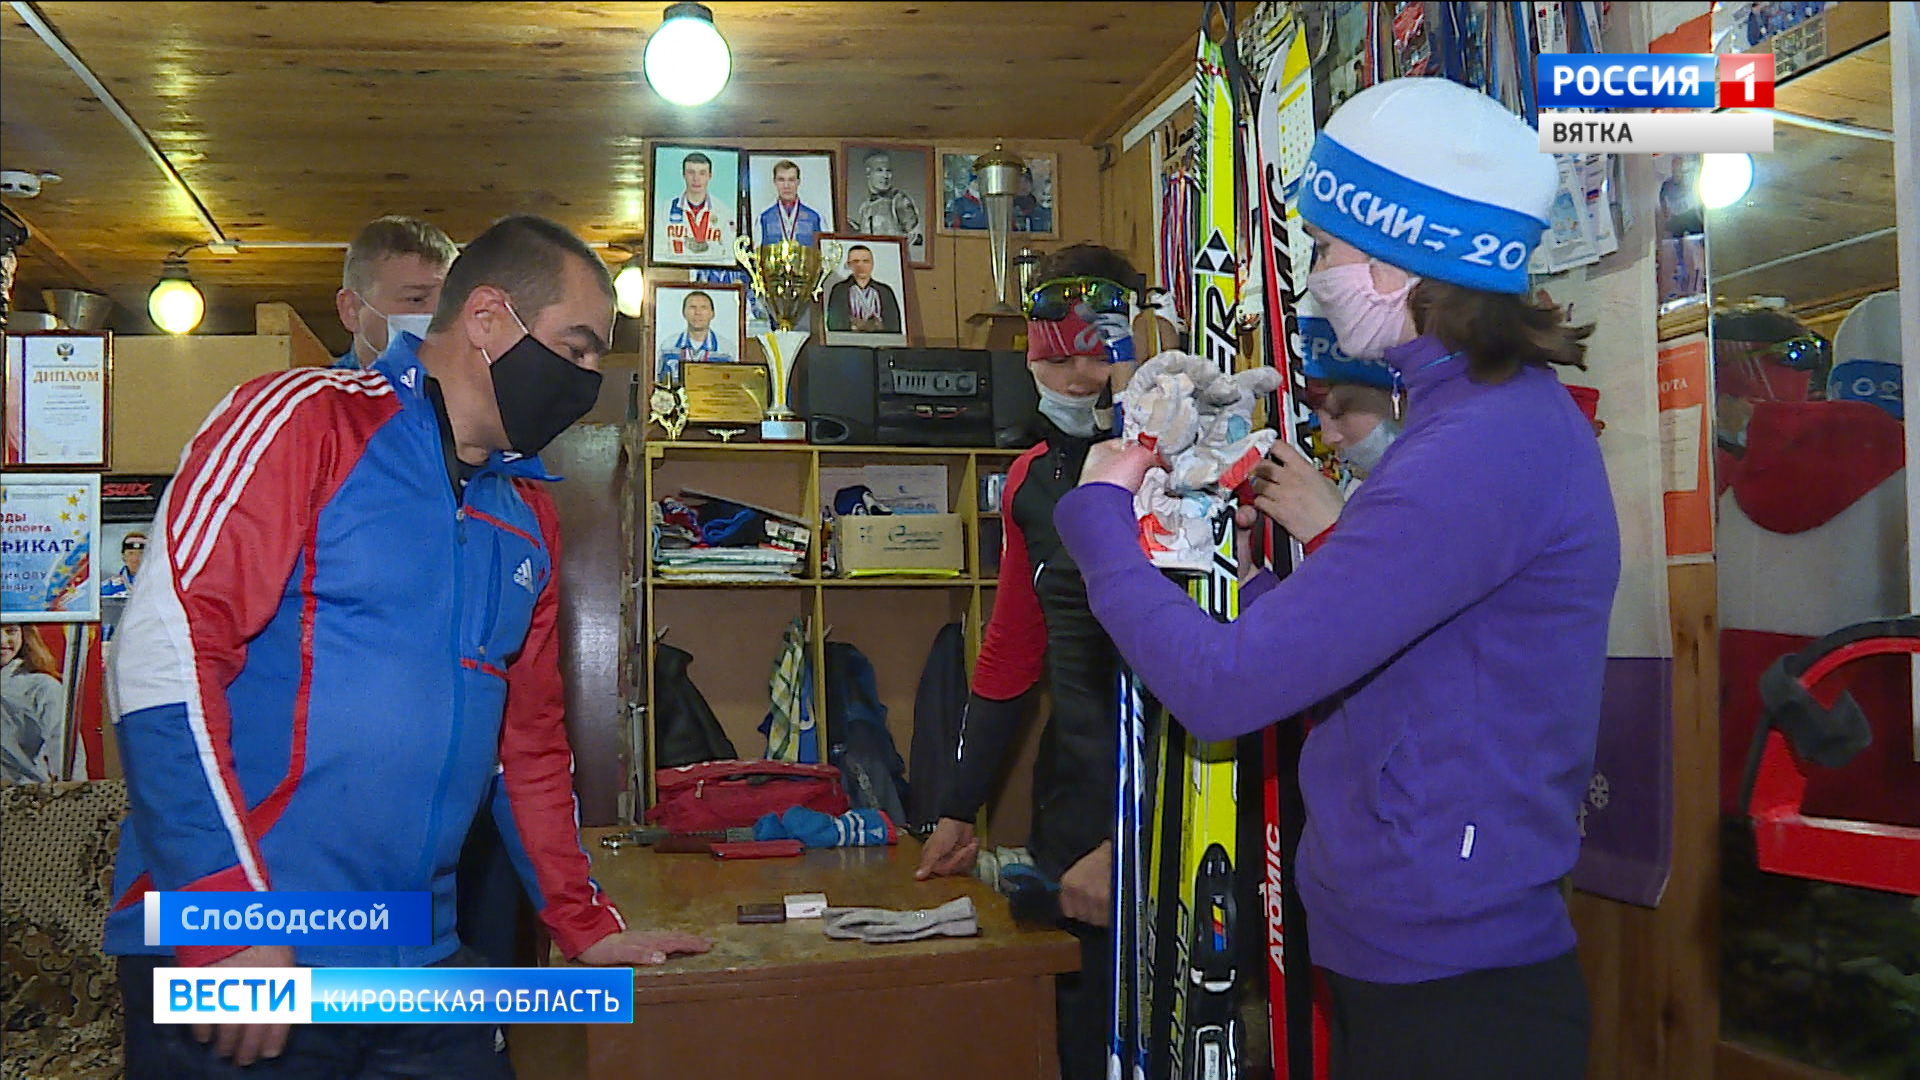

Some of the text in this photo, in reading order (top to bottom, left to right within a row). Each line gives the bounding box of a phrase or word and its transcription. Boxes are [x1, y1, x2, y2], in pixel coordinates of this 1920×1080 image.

[1303, 161, 1527, 271] РОССИИ 20
[33, 371, 100, 383] ДИПЛОМ
[1266, 822, 1286, 976] ATOMIC
